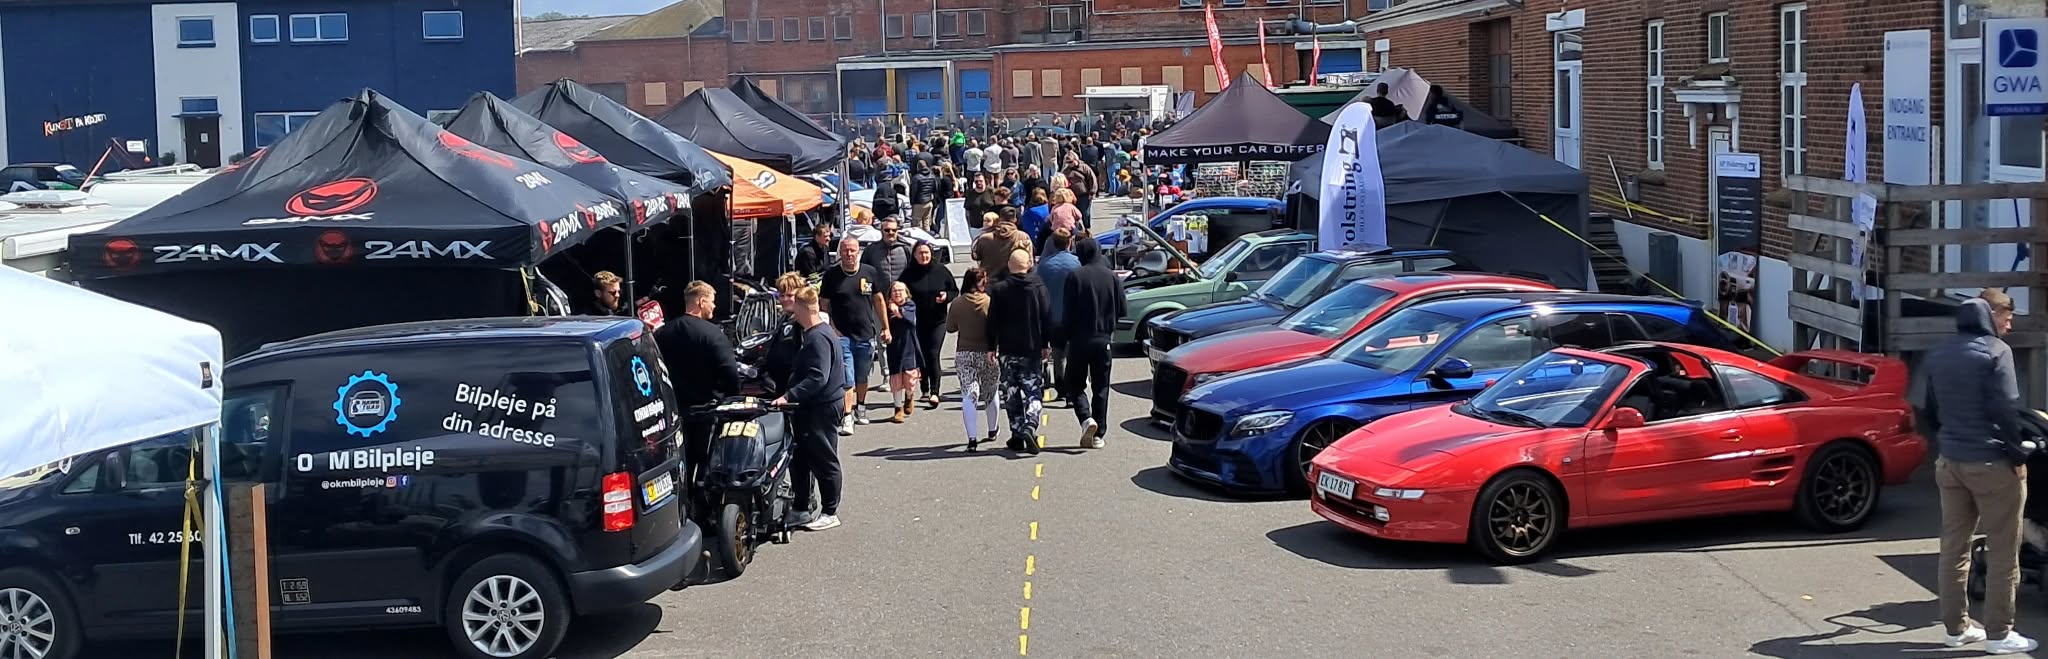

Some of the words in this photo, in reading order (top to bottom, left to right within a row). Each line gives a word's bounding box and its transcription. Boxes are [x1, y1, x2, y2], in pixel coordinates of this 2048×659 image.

[1993, 75, 2042, 93] GWA
[1888, 98, 1925, 114] INDGANG
[1887, 125, 1927, 142] ENTRANCE
[1147, 147, 1189, 158] MAKE
[1193, 146, 1233, 156] YOUR
[1238, 143, 1267, 154] CAR
[1341, 160, 1362, 247] olstring
[552, 210, 583, 245] 24MX
[152, 242, 285, 264] 24MX
[364, 239, 496, 260] 24MX
[455, 383, 527, 416] Bilpleje
[531, 397, 557, 421] på
[442, 411, 473, 434] din
[478, 419, 556, 447] adresse
[321, 478, 385, 490] @okmbilpleje
[1321, 474, 1330, 488] EK
[1338, 481, 1350, 495] 871
[128, 532, 146, 545] Tlf.
[148, 531, 165, 544] 42
[167, 530, 184, 543] 25
